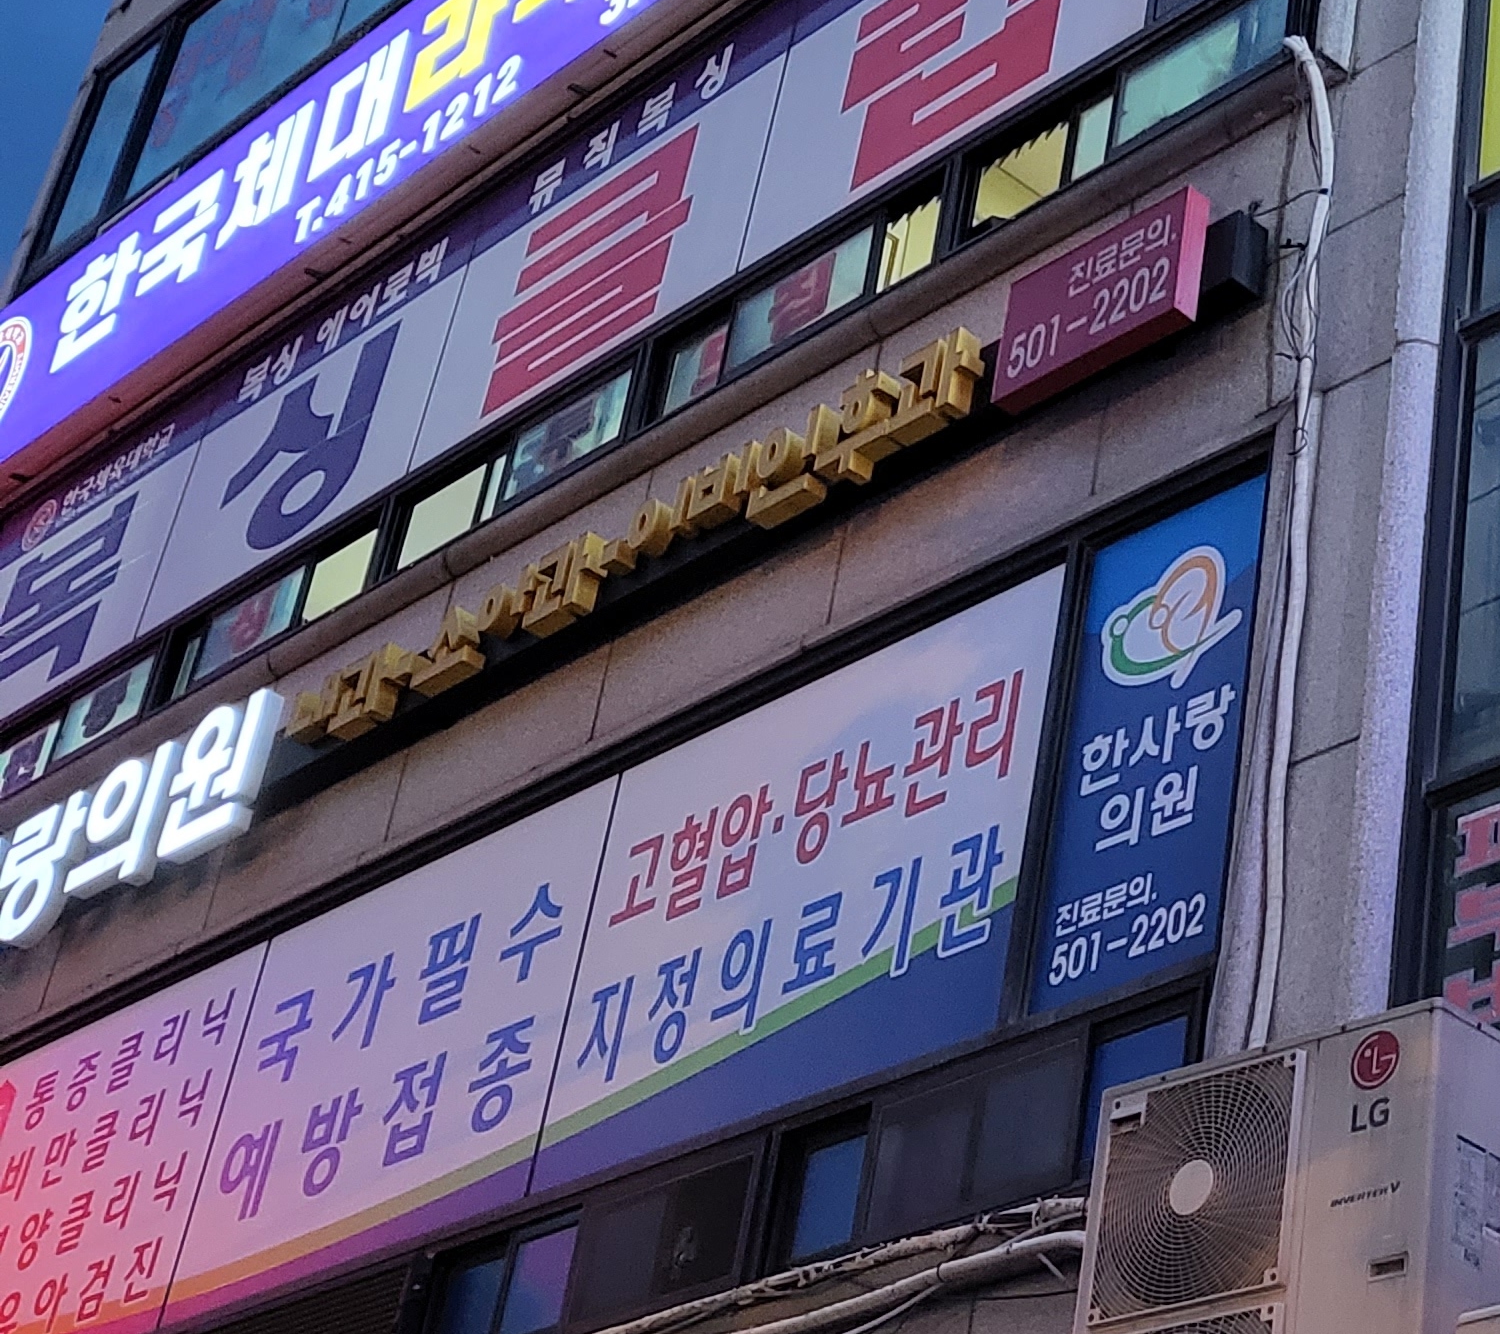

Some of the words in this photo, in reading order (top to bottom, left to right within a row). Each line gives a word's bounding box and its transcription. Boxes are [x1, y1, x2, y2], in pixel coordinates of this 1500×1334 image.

[294, 55, 522, 245] T.415-1212
[239, 336, 303, 403] 복싱
[316, 237, 450, 349] 에어로빅
[1007, 257, 1171, 380] 501-2202
[1080, 683, 1236, 797] 한사랑
[0, 687, 284, 949] 랑의원
[1094, 766, 1199, 852] 의원
[1048, 892, 1207, 987] 501-2202
[1351, 1096, 1391, 1134] LG
[0, 1151, 188, 1271] 양클리닉
